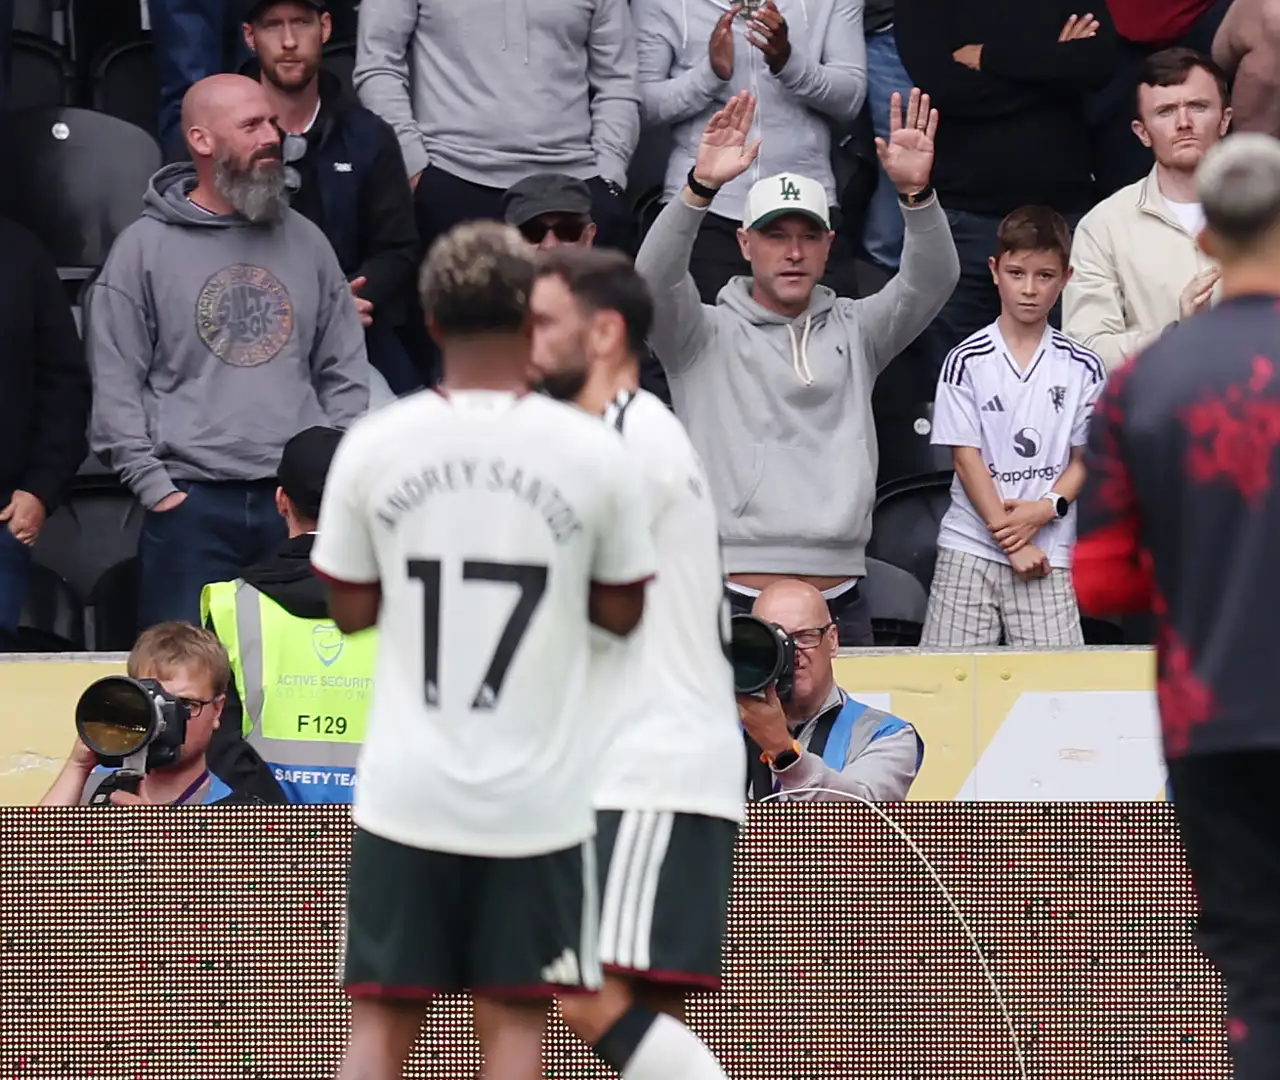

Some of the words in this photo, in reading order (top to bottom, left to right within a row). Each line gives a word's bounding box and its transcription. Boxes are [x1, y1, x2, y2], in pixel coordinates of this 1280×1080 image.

[780, 177, 801, 200] LA
[406, 557, 550, 710] 17
[277, 674, 318, 687] ACTIVE
[297, 715, 348, 735] F129
[275, 768, 333, 785] SAFETY
[333, 773, 358, 787] TEA
